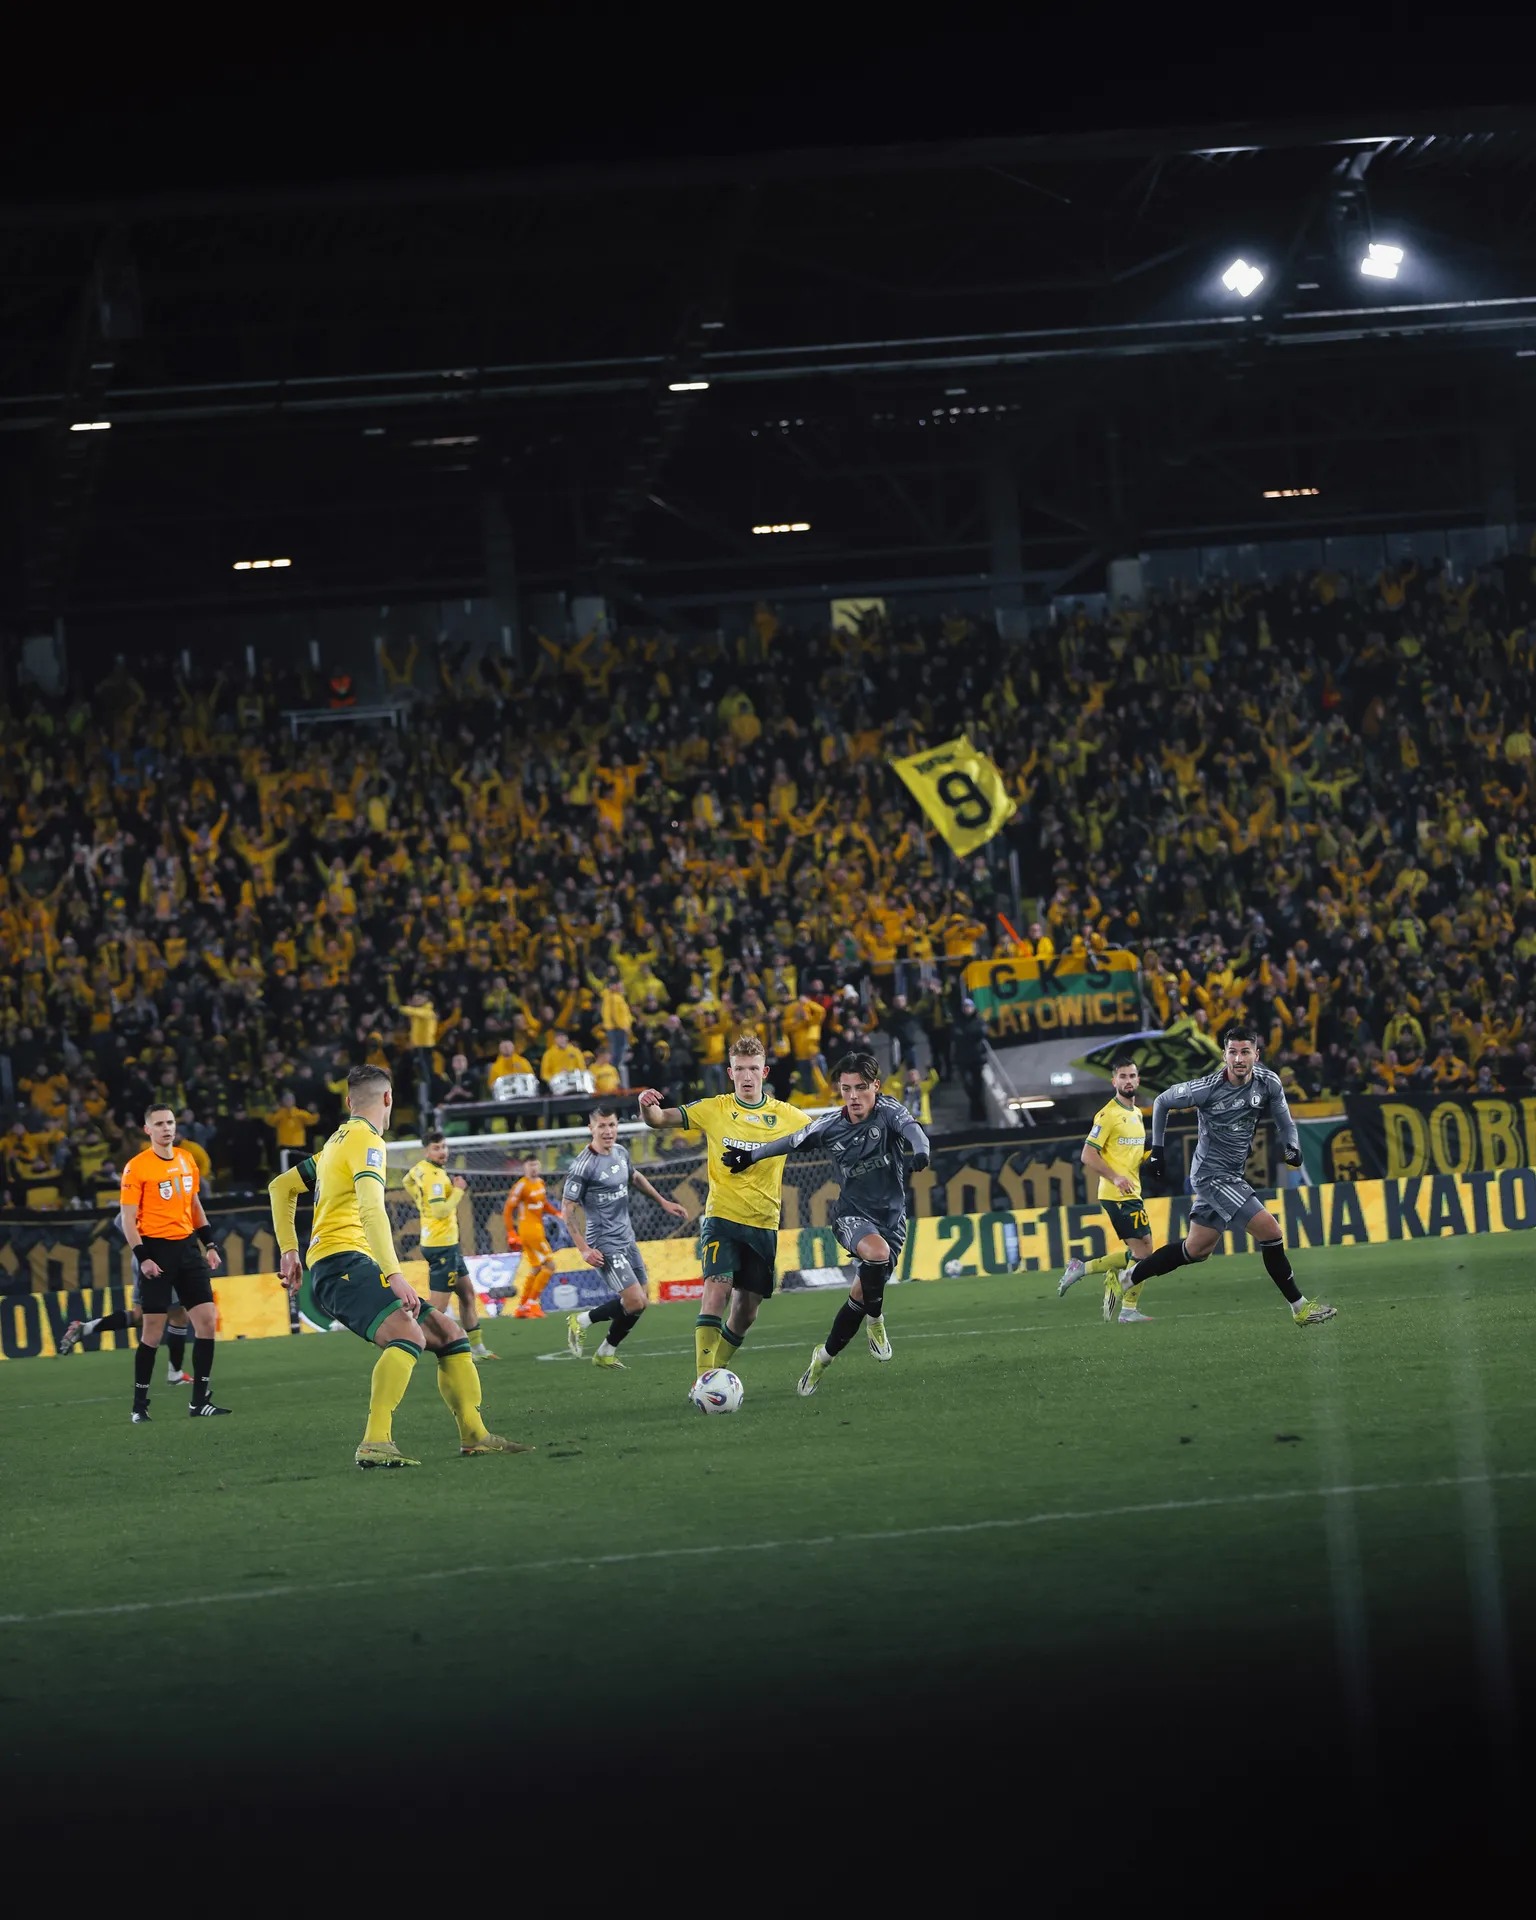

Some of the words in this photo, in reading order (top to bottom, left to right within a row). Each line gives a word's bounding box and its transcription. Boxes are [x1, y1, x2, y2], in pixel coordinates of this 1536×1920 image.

[937, 771, 993, 829] 9
[1129, 1210, 1149, 1229] 70
[702, 1241, 720, 1268] 77
[937, 1204, 1108, 1278] 20:15
